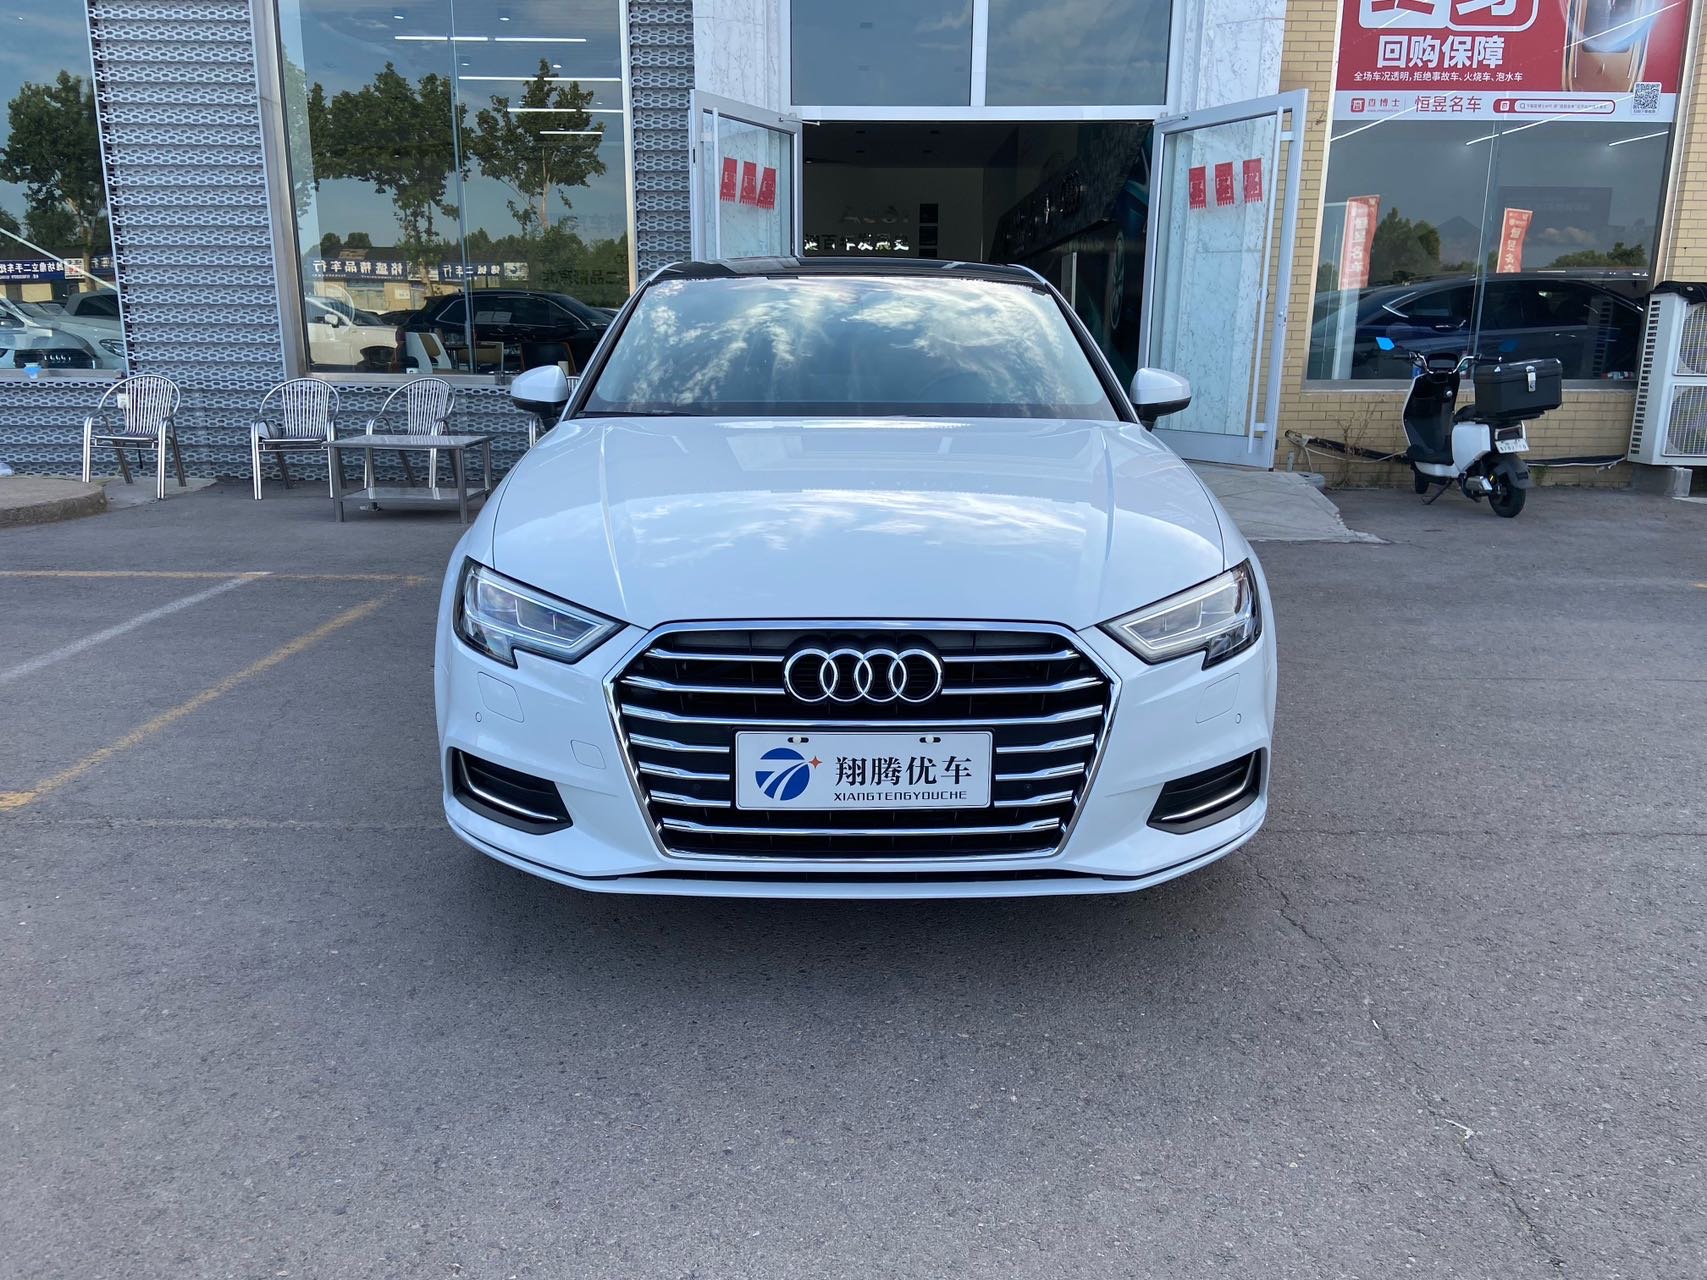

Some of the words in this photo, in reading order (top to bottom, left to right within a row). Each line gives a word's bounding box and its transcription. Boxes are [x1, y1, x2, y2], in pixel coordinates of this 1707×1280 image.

[1377, 35, 1505, 68] 回购保障
[1414, 95, 1483, 113] 恒昱名车
[834, 756, 972, 786] 翔腾优车
[833, 790, 968, 801] XIANGTENGYOUCHE
